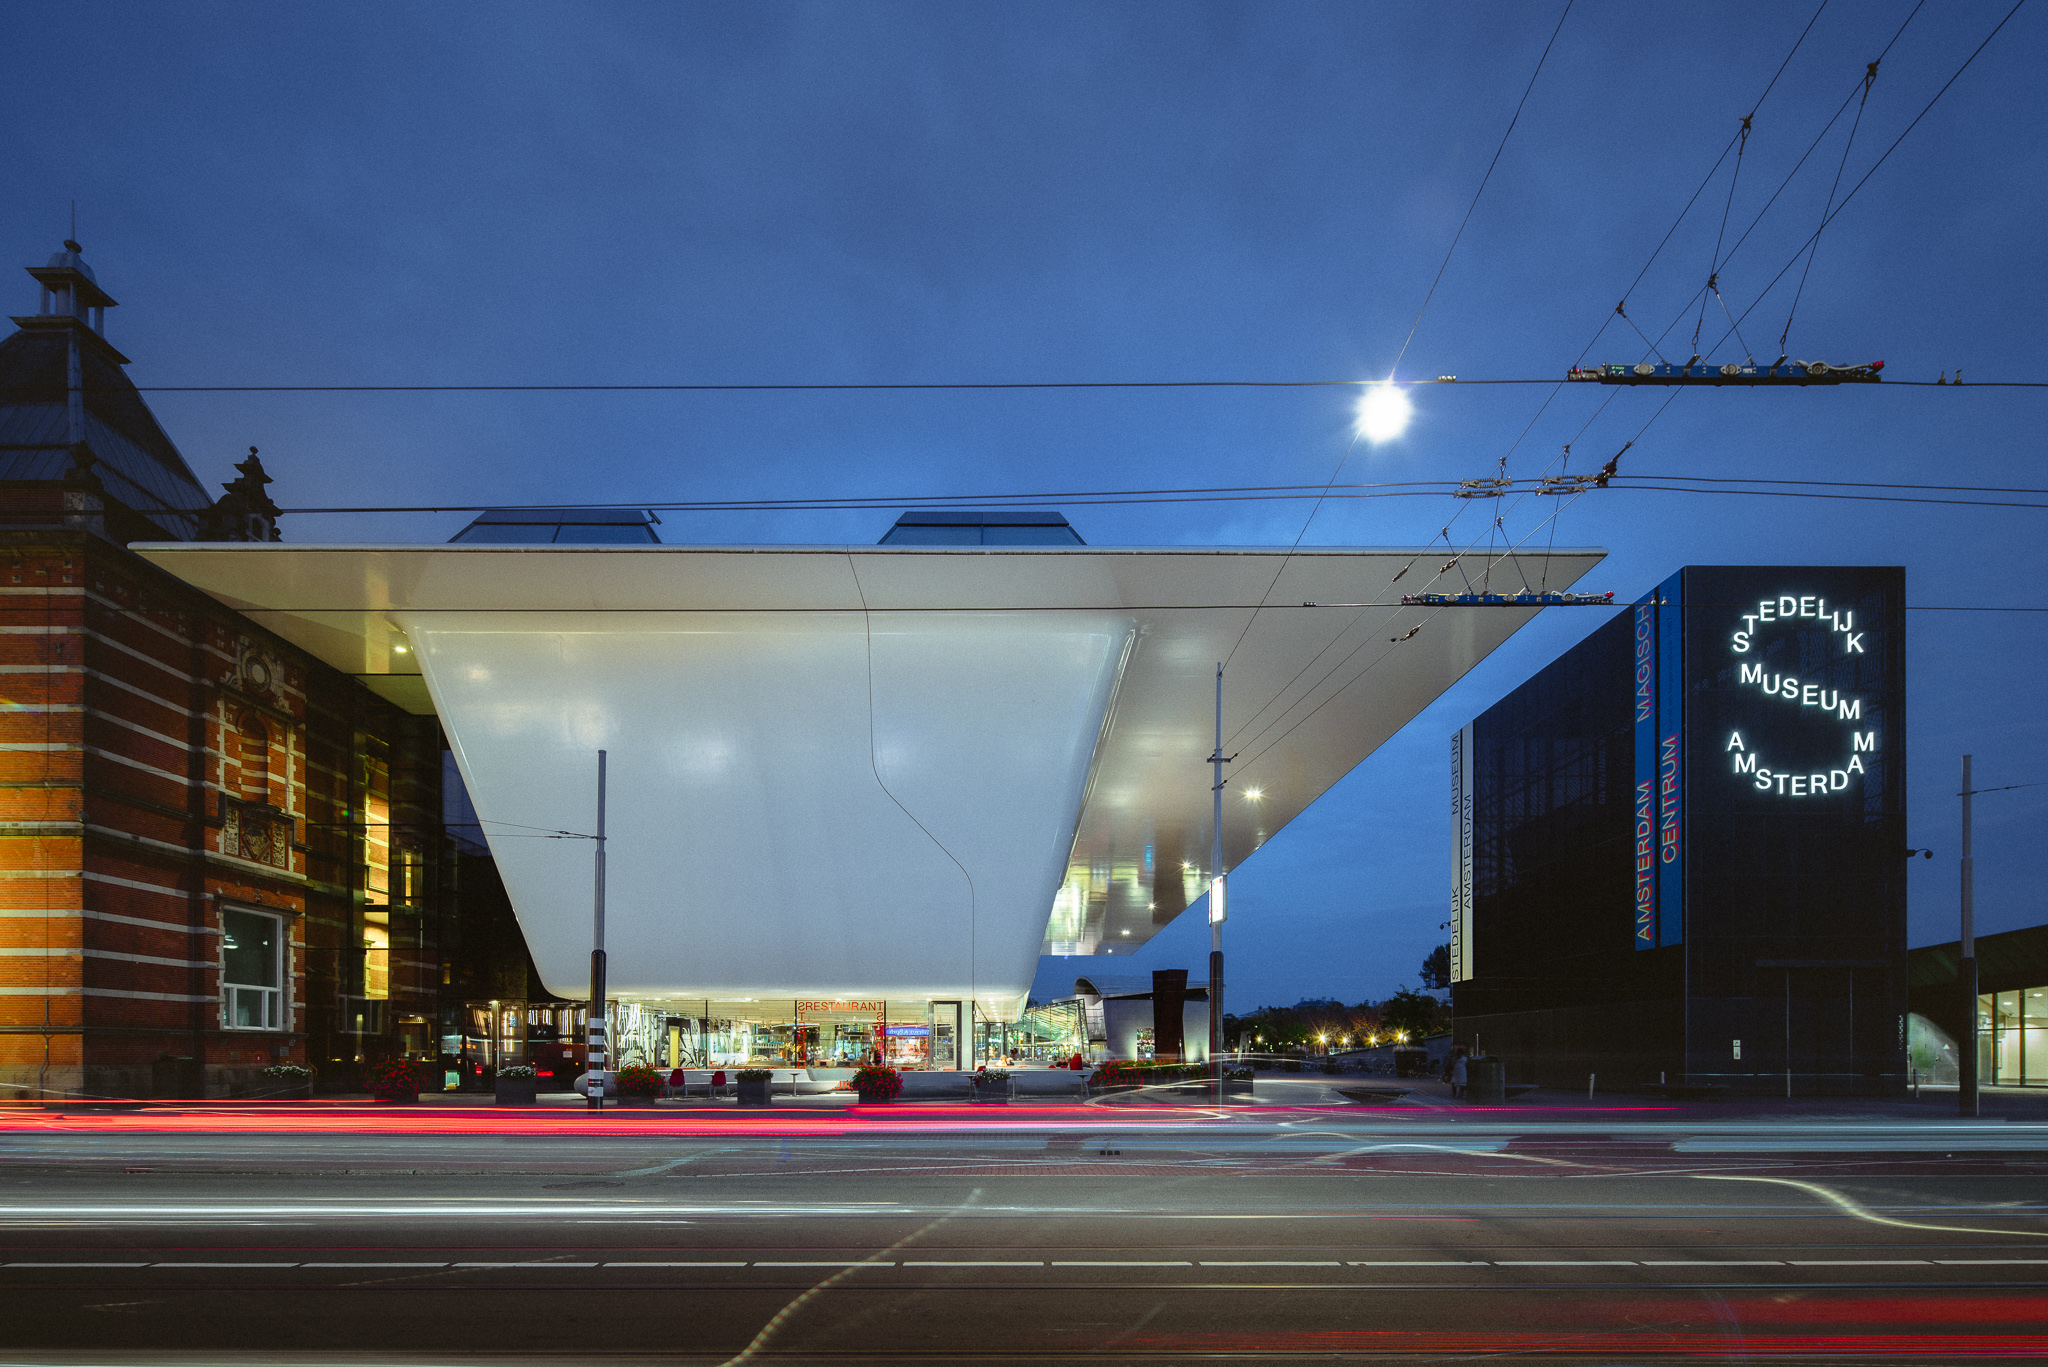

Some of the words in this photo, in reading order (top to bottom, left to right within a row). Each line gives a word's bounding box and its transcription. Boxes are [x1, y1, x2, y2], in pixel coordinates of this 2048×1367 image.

[1637, 597, 1653, 723] MAGISCH
[1732, 596, 1864, 653] STEDELIJK
[1740, 663, 1860, 720] MUSEUM
[1662, 732, 1679, 864] CENTRUM
[1727, 731, 1874, 796] AMSTERDAM
[1637, 778, 1653, 941] AMSTERDAM
